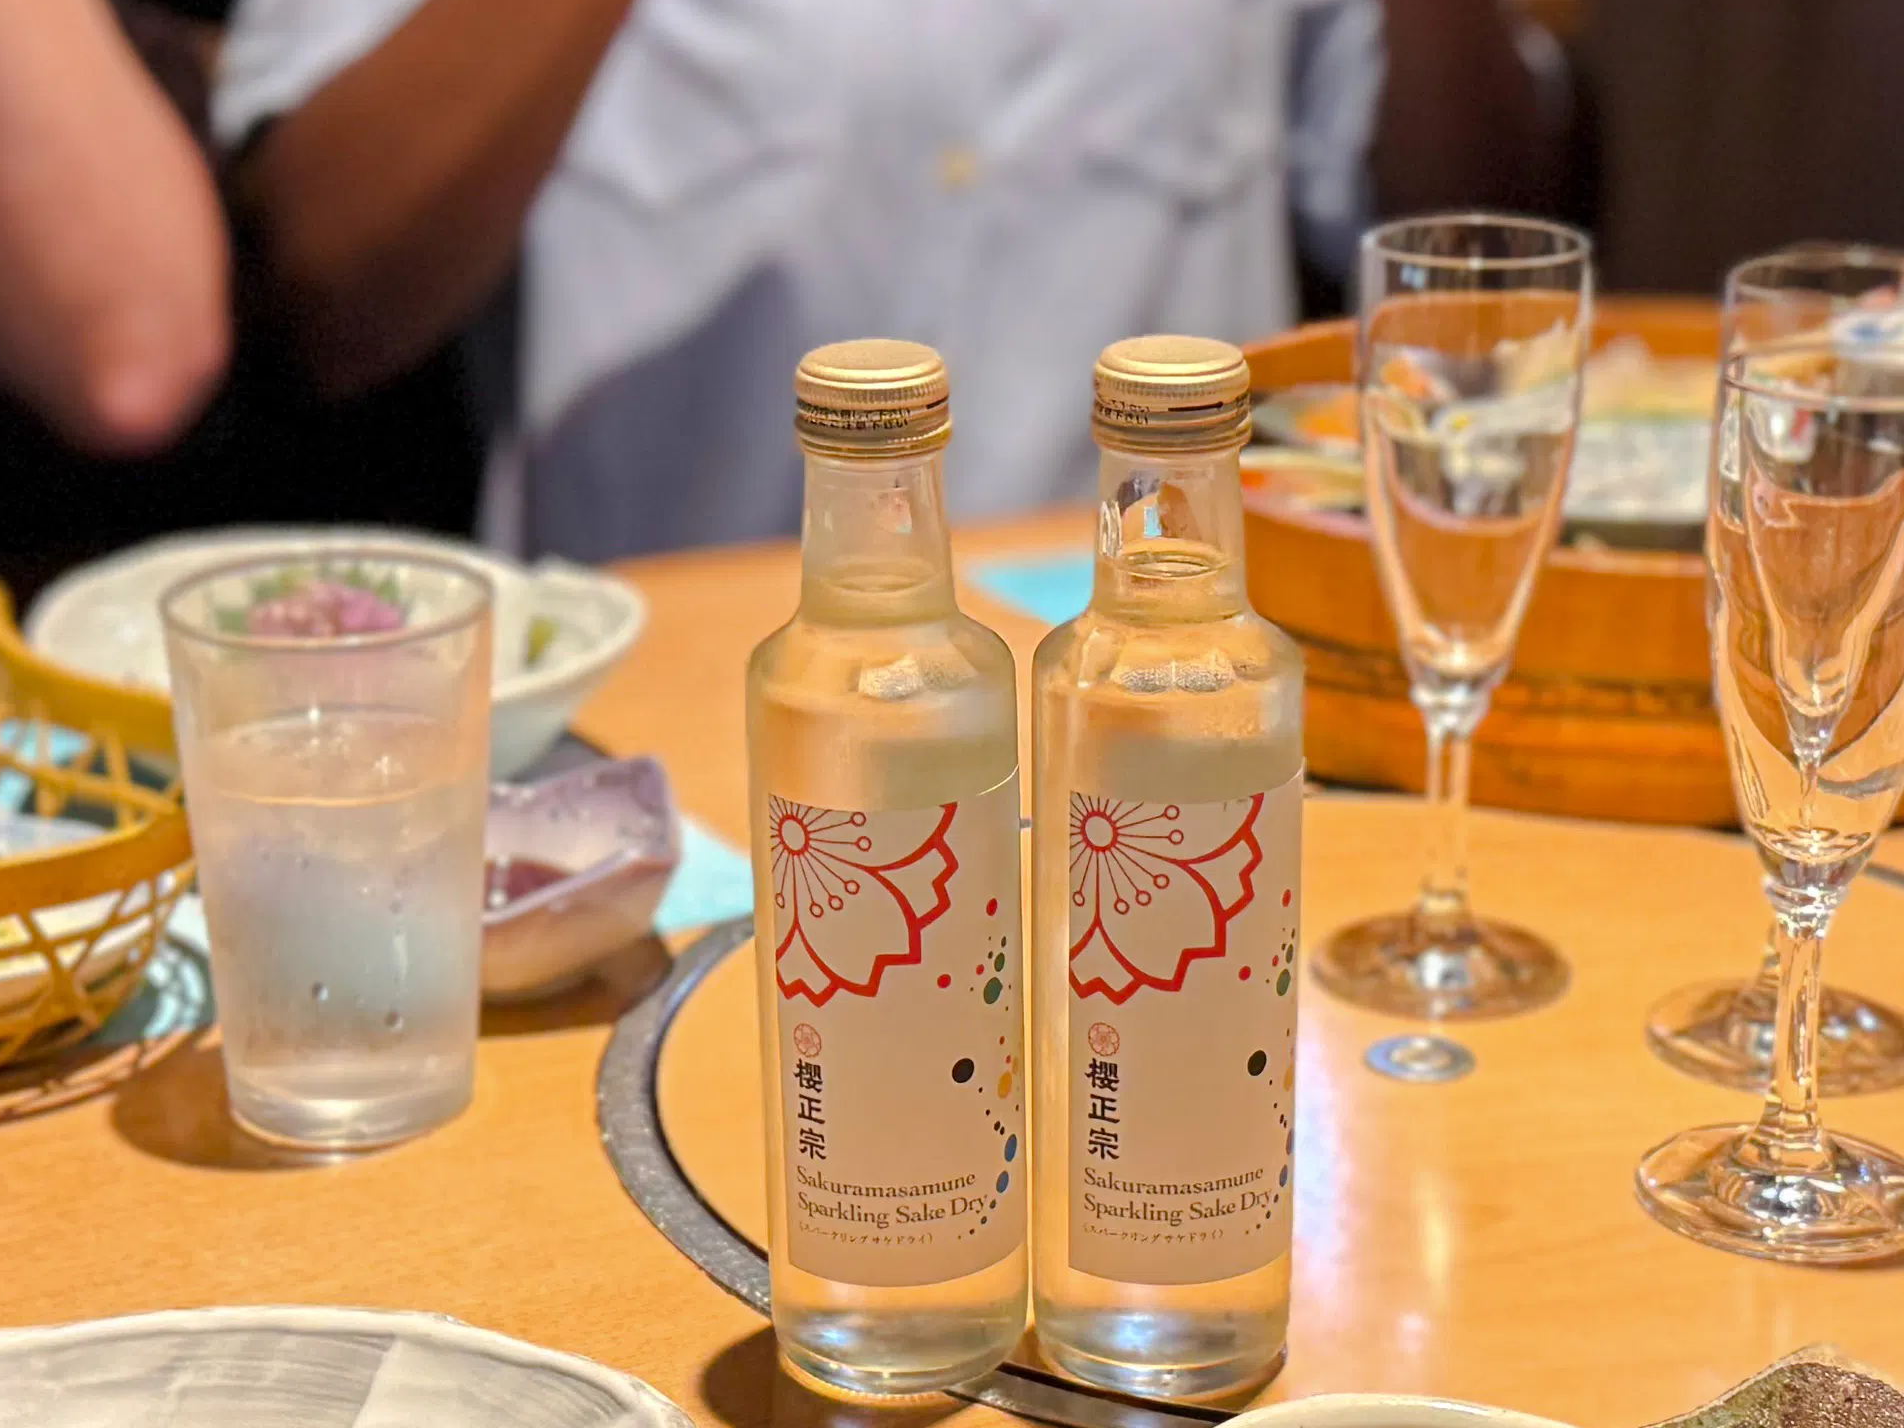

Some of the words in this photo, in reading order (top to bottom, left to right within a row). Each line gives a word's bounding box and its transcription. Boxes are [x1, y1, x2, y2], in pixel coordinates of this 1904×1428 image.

[793, 1058, 827, 1160] 櫻正宗
[1085, 1058, 1121, 1160] 櫻正宗
[797, 1165, 976, 1198] Sakuramasamune
[1084, 1167, 1264, 1196] Sakuramasamune
[798, 1192, 890, 1229] Sparkling
[896, 1203, 946, 1224] Sake
[950, 1195, 988, 1216] Dry
[1084, 1193, 1183, 1226] Sparkling
[1189, 1199, 1236, 1221] Sake
[1240, 1189, 1274, 1212] Dry
